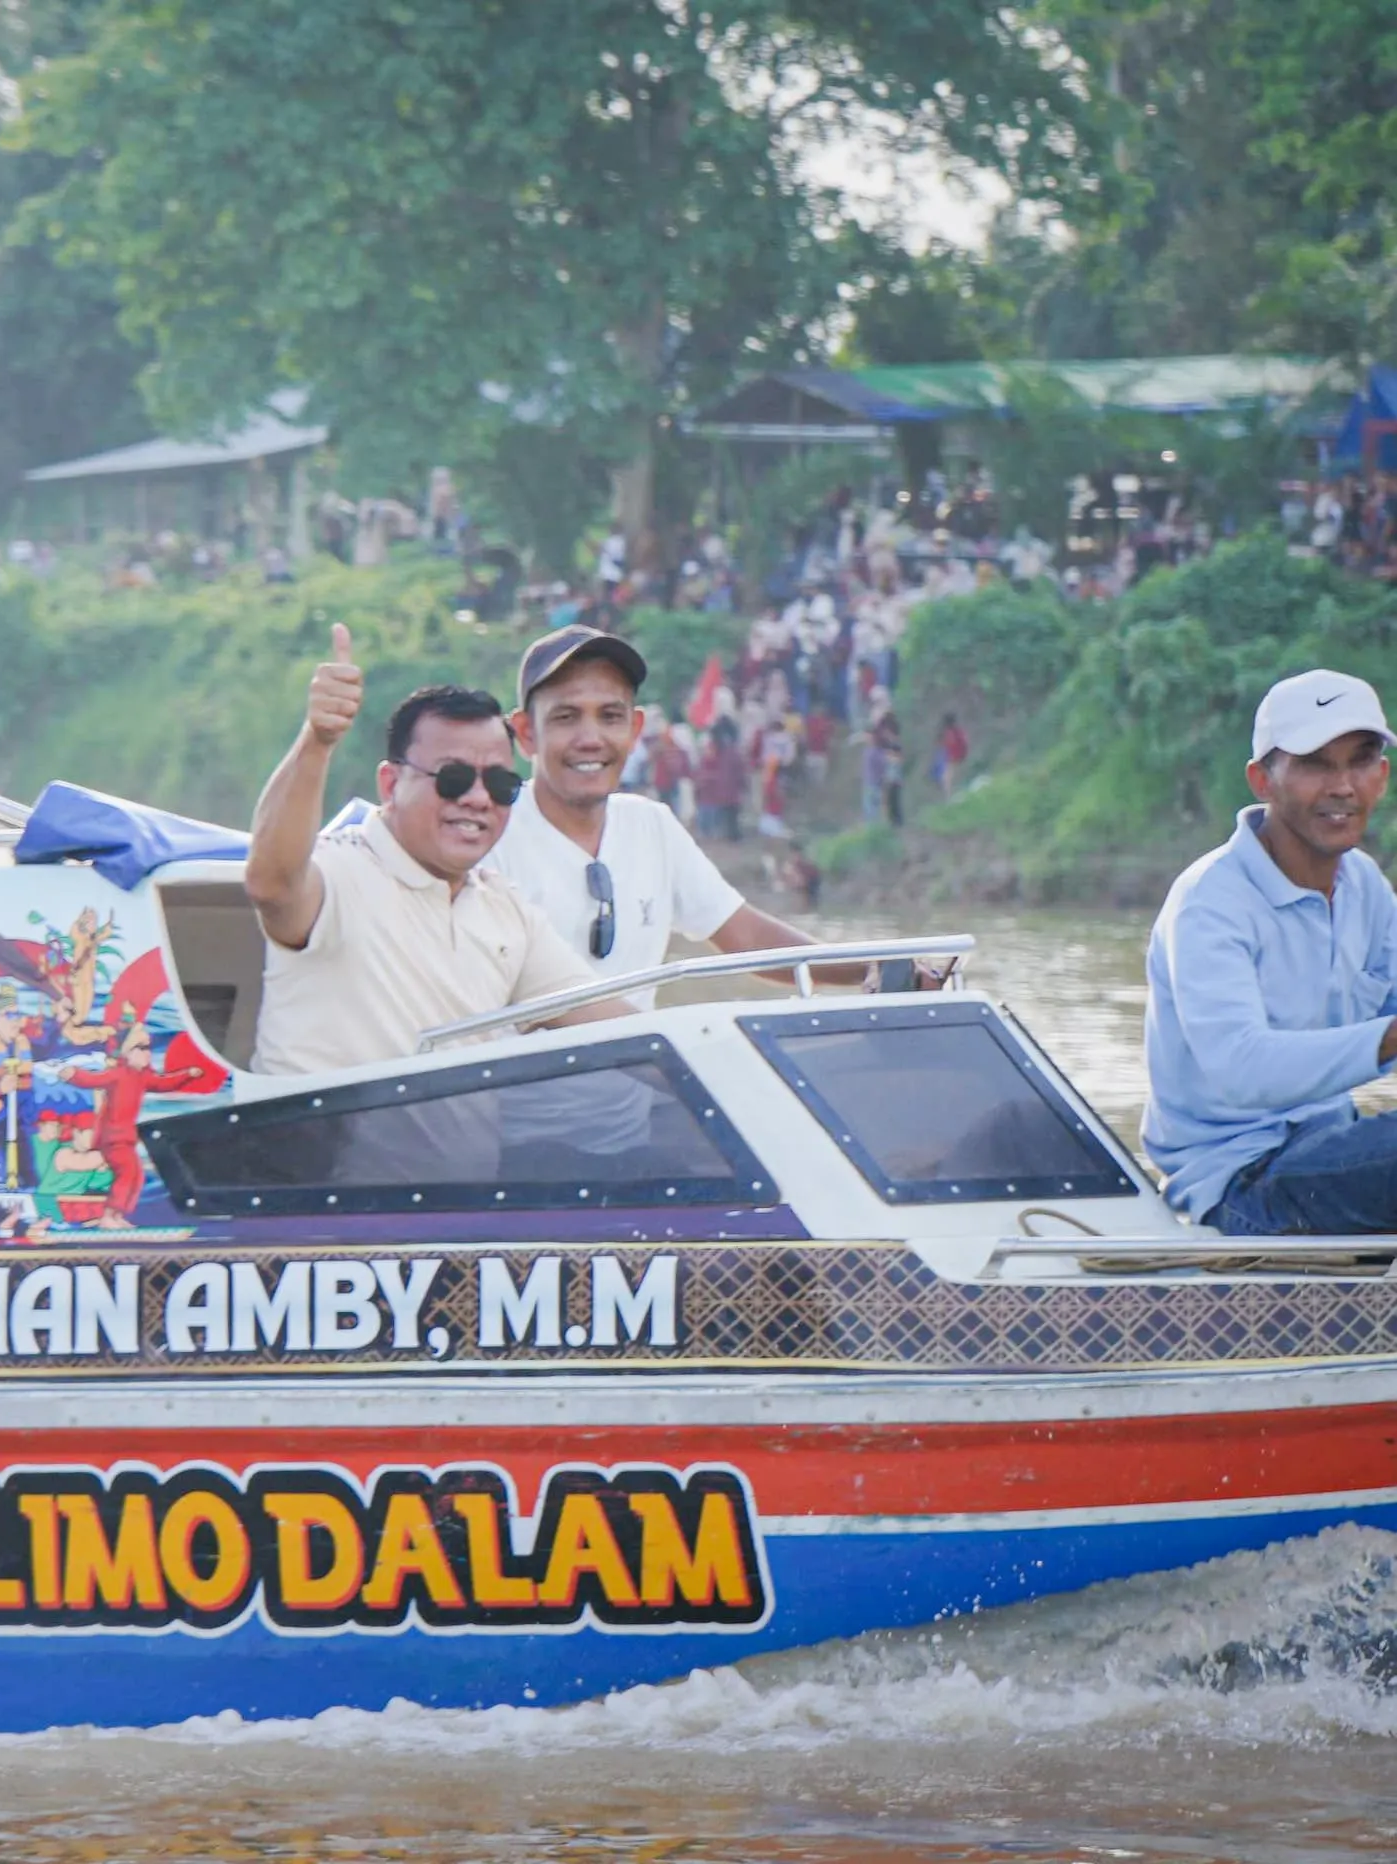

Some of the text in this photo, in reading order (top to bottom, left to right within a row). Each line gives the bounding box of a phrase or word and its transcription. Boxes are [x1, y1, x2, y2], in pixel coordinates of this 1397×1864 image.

[164, 1259, 451, 1360] AMBY,
[477, 1255, 680, 1350] M.M
[262, 1490, 753, 1610] DALAM
